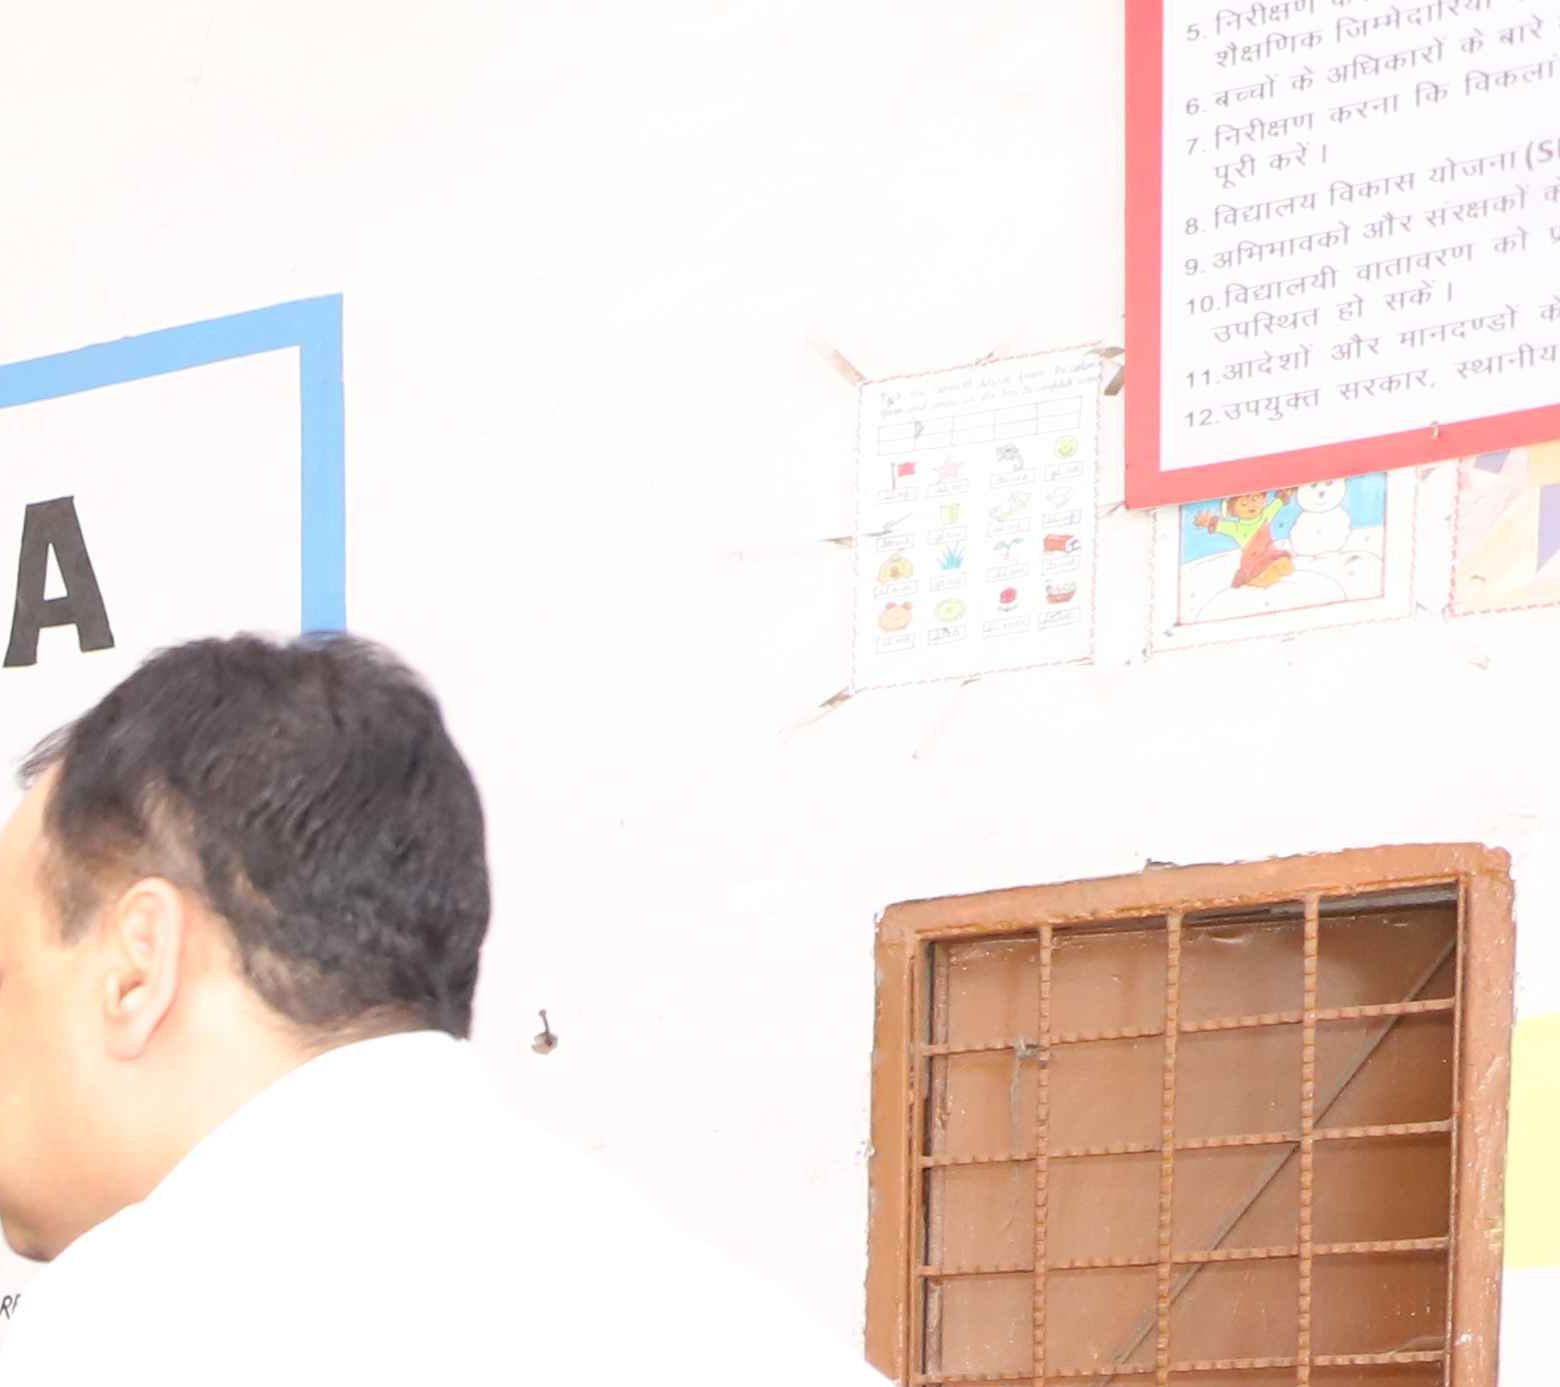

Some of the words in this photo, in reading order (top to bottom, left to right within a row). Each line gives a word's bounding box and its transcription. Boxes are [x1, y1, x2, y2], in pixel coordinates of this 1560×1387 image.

[1186, 98, 1207, 116] 6.
[1215, 73, 1276, 109] बच्चों
[1291, 66, 1316, 93] के
[1327, 38, 1446, 85] अधिकारों
[1460, 29, 1485, 56] के
[1500, 15, 1544, 47] बारे
[1216, 29, 1323, 69] शैक्षणिक
[1187, 137, 1207, 155] 7.
[1215, 112, 1316, 151] निरीक्षण
[1329, 92, 1400, 126] करना
[1416, 80, 1449, 108] कि
[1214, 153, 1256, 190] पूरी
[1269, 141, 1309, 172] करें
[1184, 218, 1207, 236] 8.
[1214, 192, 1317, 230] विद्यालय
[1329, 172, 1416, 208] विकास
[1184, 258, 1207, 276] 9.
[1362, 210, 1413, 241] और
[1356, 241, 1474, 282] वातावरण
[1493, 226, 1530, 253] को
[1213, 306, 1320, 343] उपस्थित
[1338, 294, 1364, 322] हो
[1385, 281, 1434, 312] सकें
[1330, 331, 1380, 363] और
